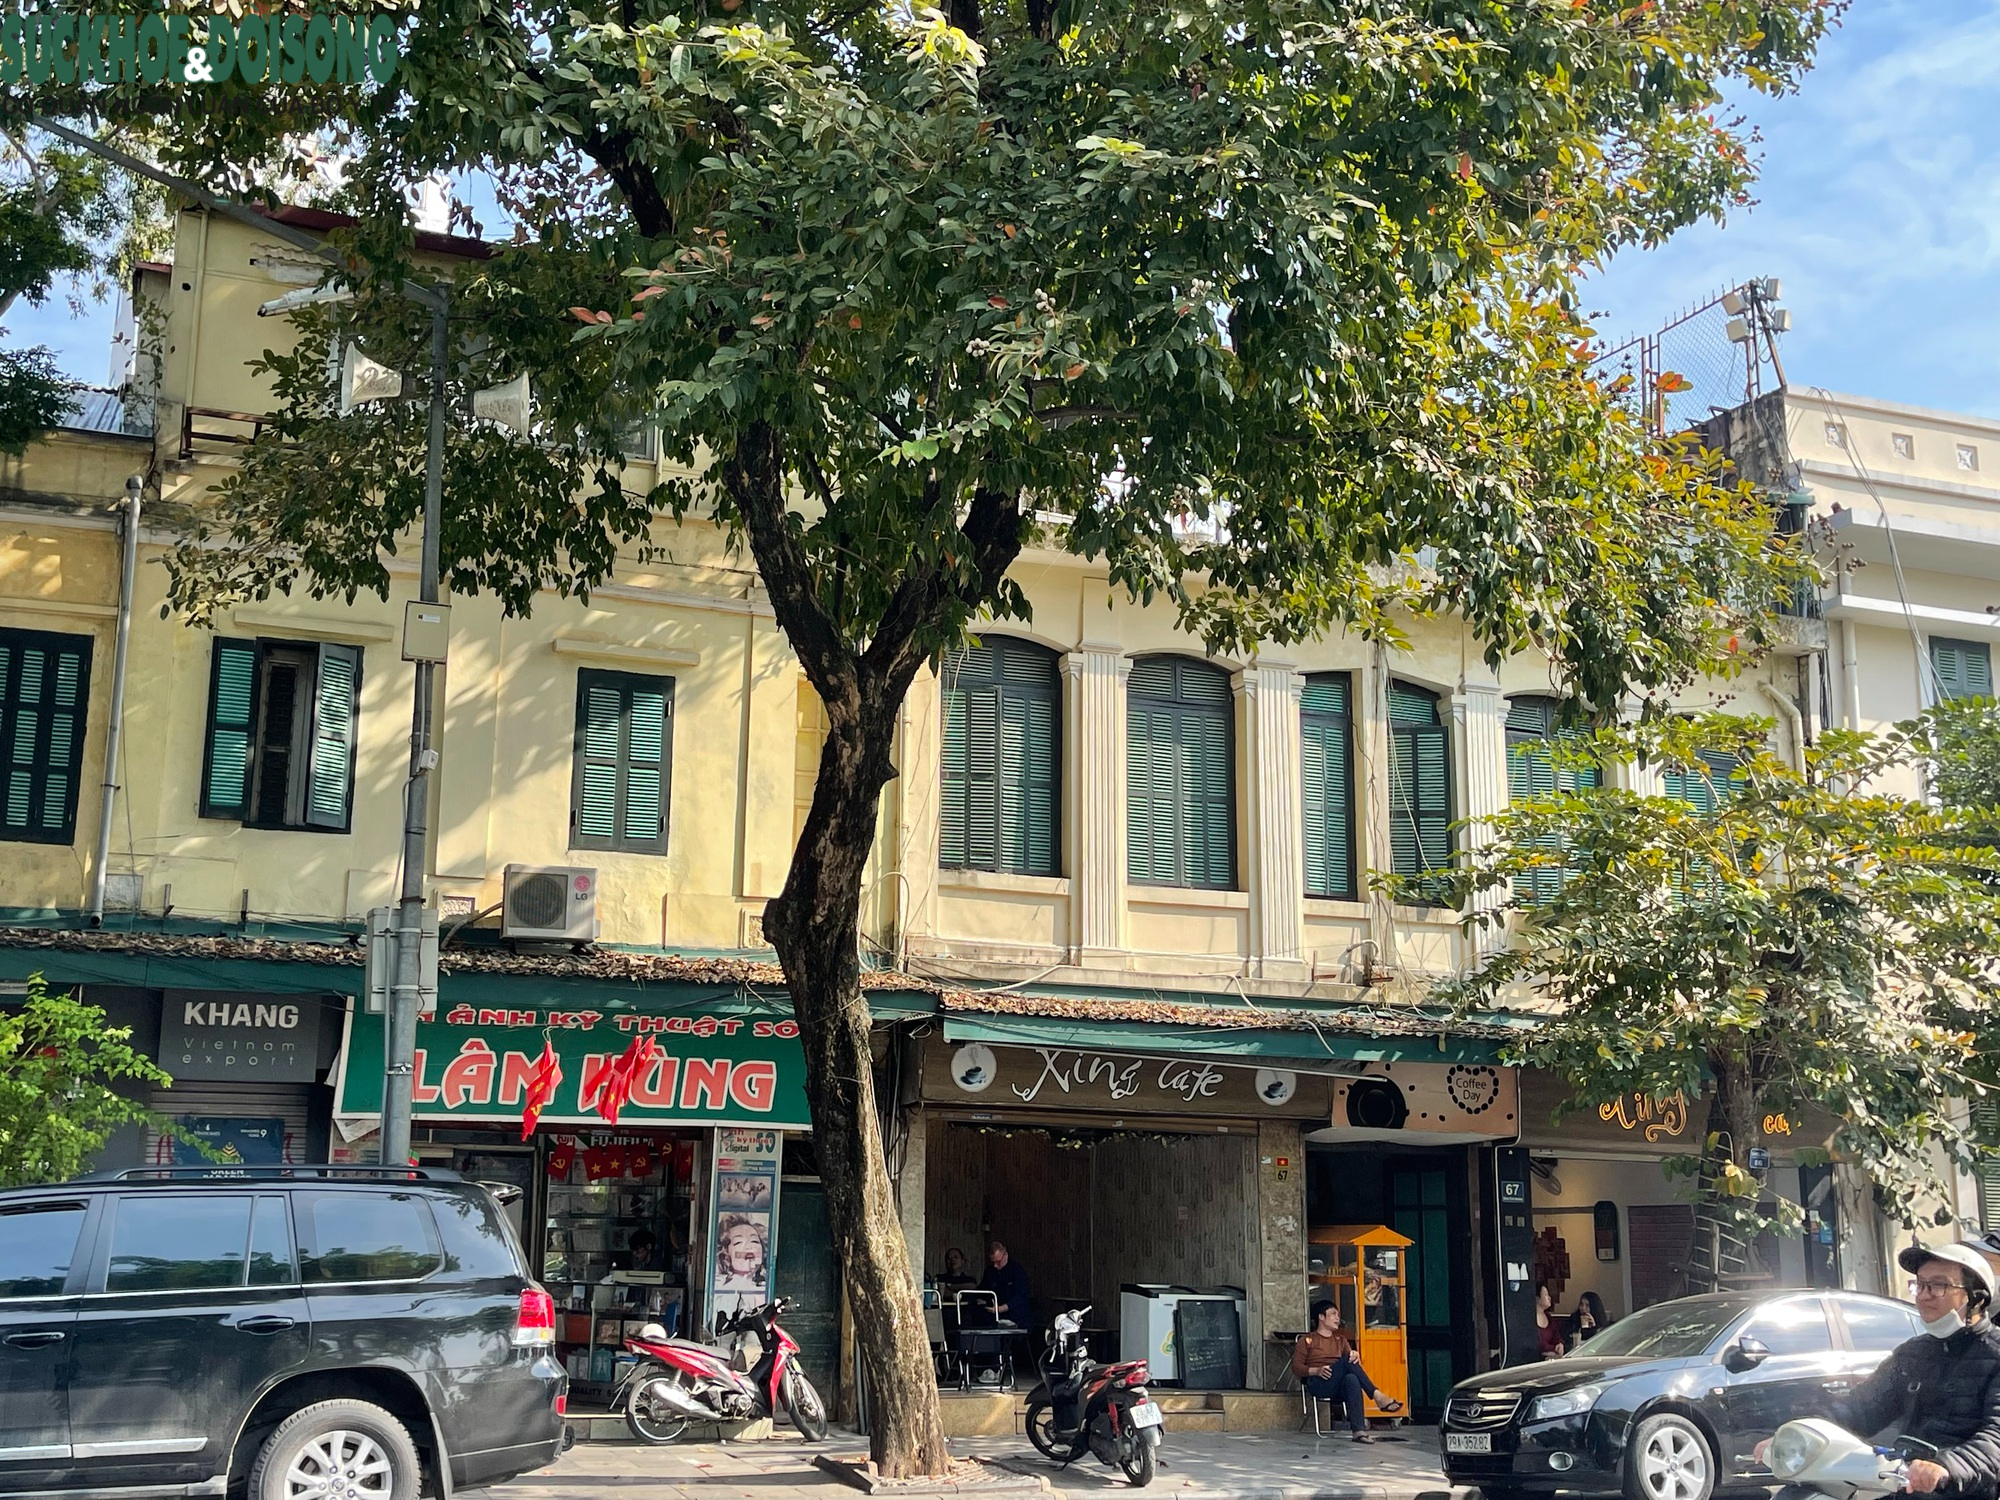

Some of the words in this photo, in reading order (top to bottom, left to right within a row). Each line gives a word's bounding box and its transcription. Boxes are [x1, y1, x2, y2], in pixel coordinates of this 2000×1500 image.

[575, 892, 588, 901] LG
[183, 1001, 299, 1029] KHANG
[447, 1003, 537, 1026] ẢNH
[613, 1014, 744, 1037] THUẬT
[183, 1037, 295, 1052] Vietnam
[182, 1054, 294, 1067] export
[1455, 1077, 1487, 1090] Coffee
[1462, 1089, 1481, 1103] Day
[1277, 1170, 1288, 1180] 67
[1505, 1183, 1520, 1196] 67
